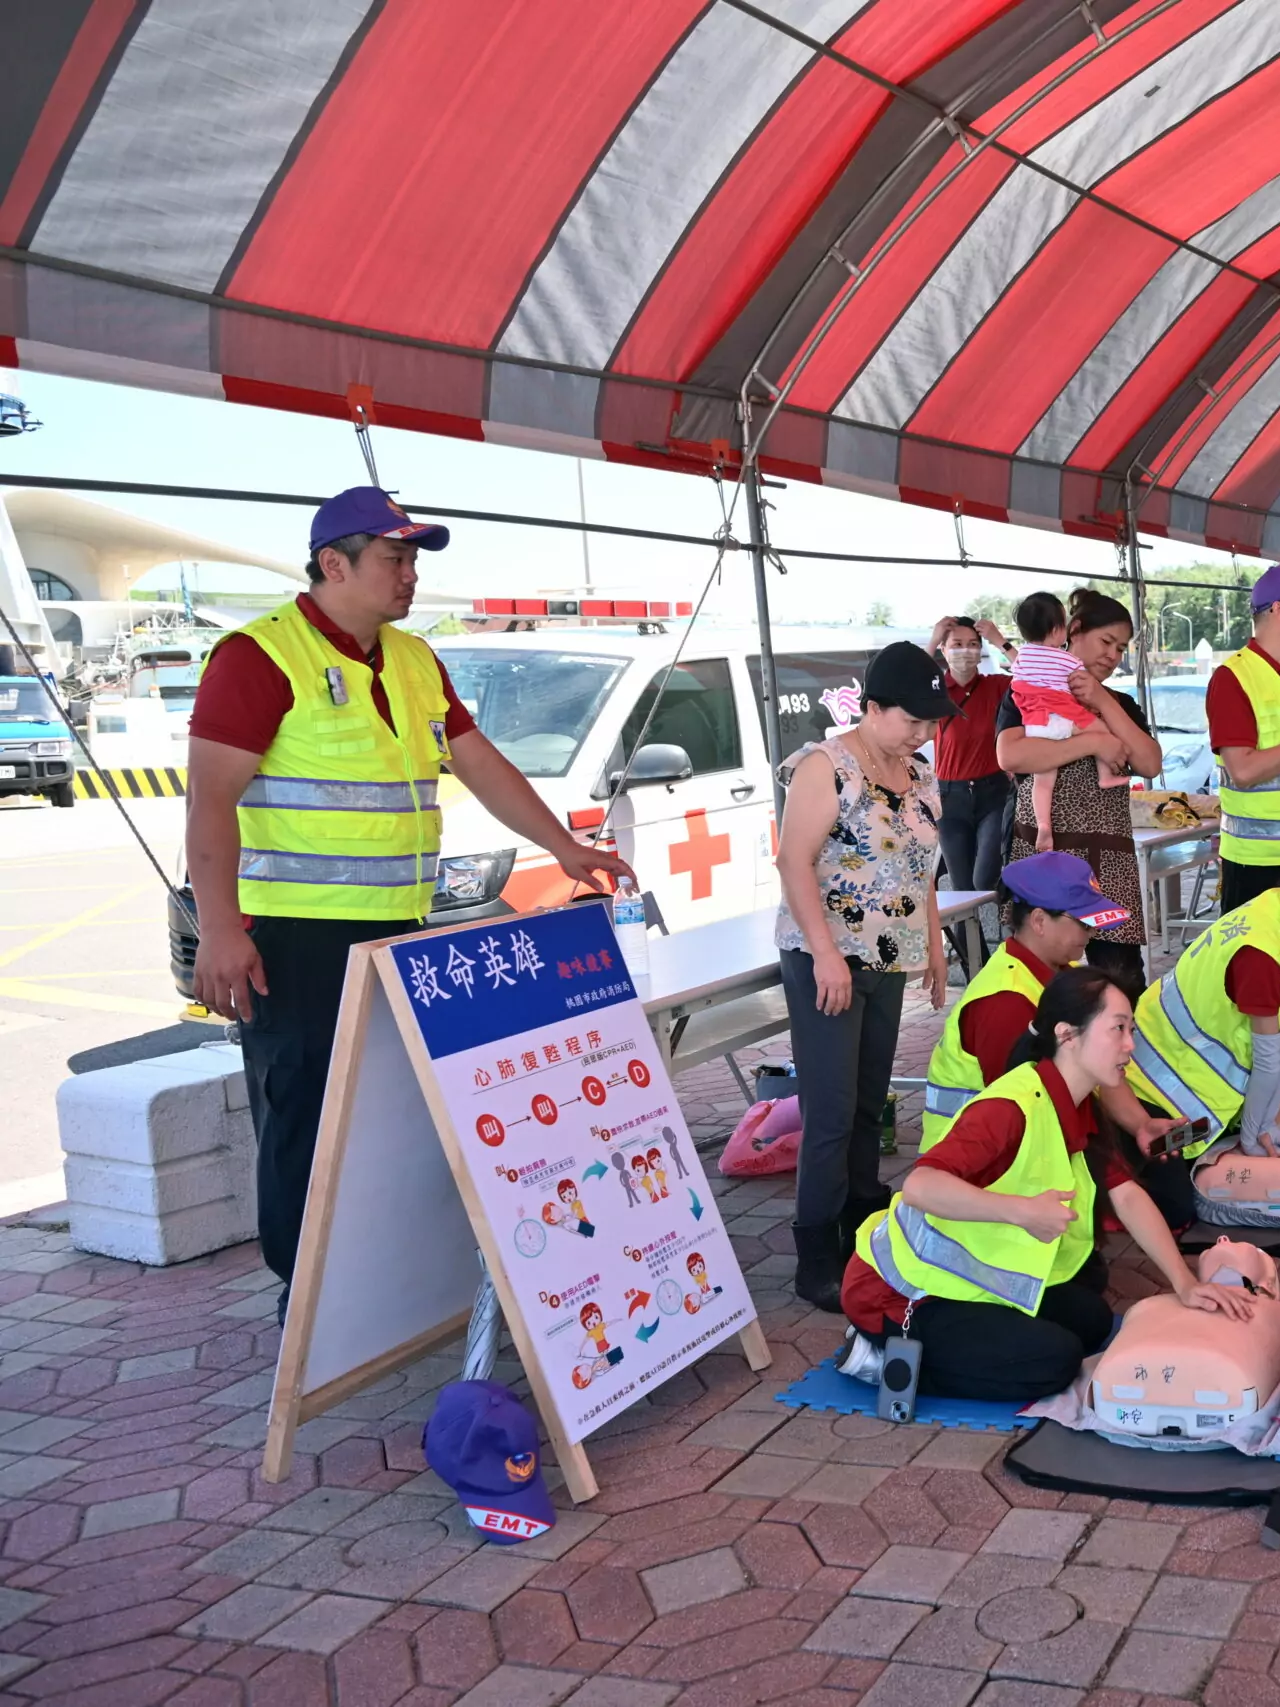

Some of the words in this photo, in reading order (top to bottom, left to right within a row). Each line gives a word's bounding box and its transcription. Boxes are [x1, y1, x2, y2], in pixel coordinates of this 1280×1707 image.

[1095, 910, 1125, 924] EMT
[408, 929, 546, 1008] 救命英雄
[556, 949, 614, 979] 趣味競賽
[565, 980, 631, 1010] 桃園市政府消防局
[473, 1029, 603, 1087] 心肺復甦程序
[482, 1119, 501, 1140] 叫
[537, 1098, 555, 1118] 叫
[587, 1081, 601, 1100] C
[632, 1064, 646, 1083] D
[484, 1512, 539, 1535] EMT
